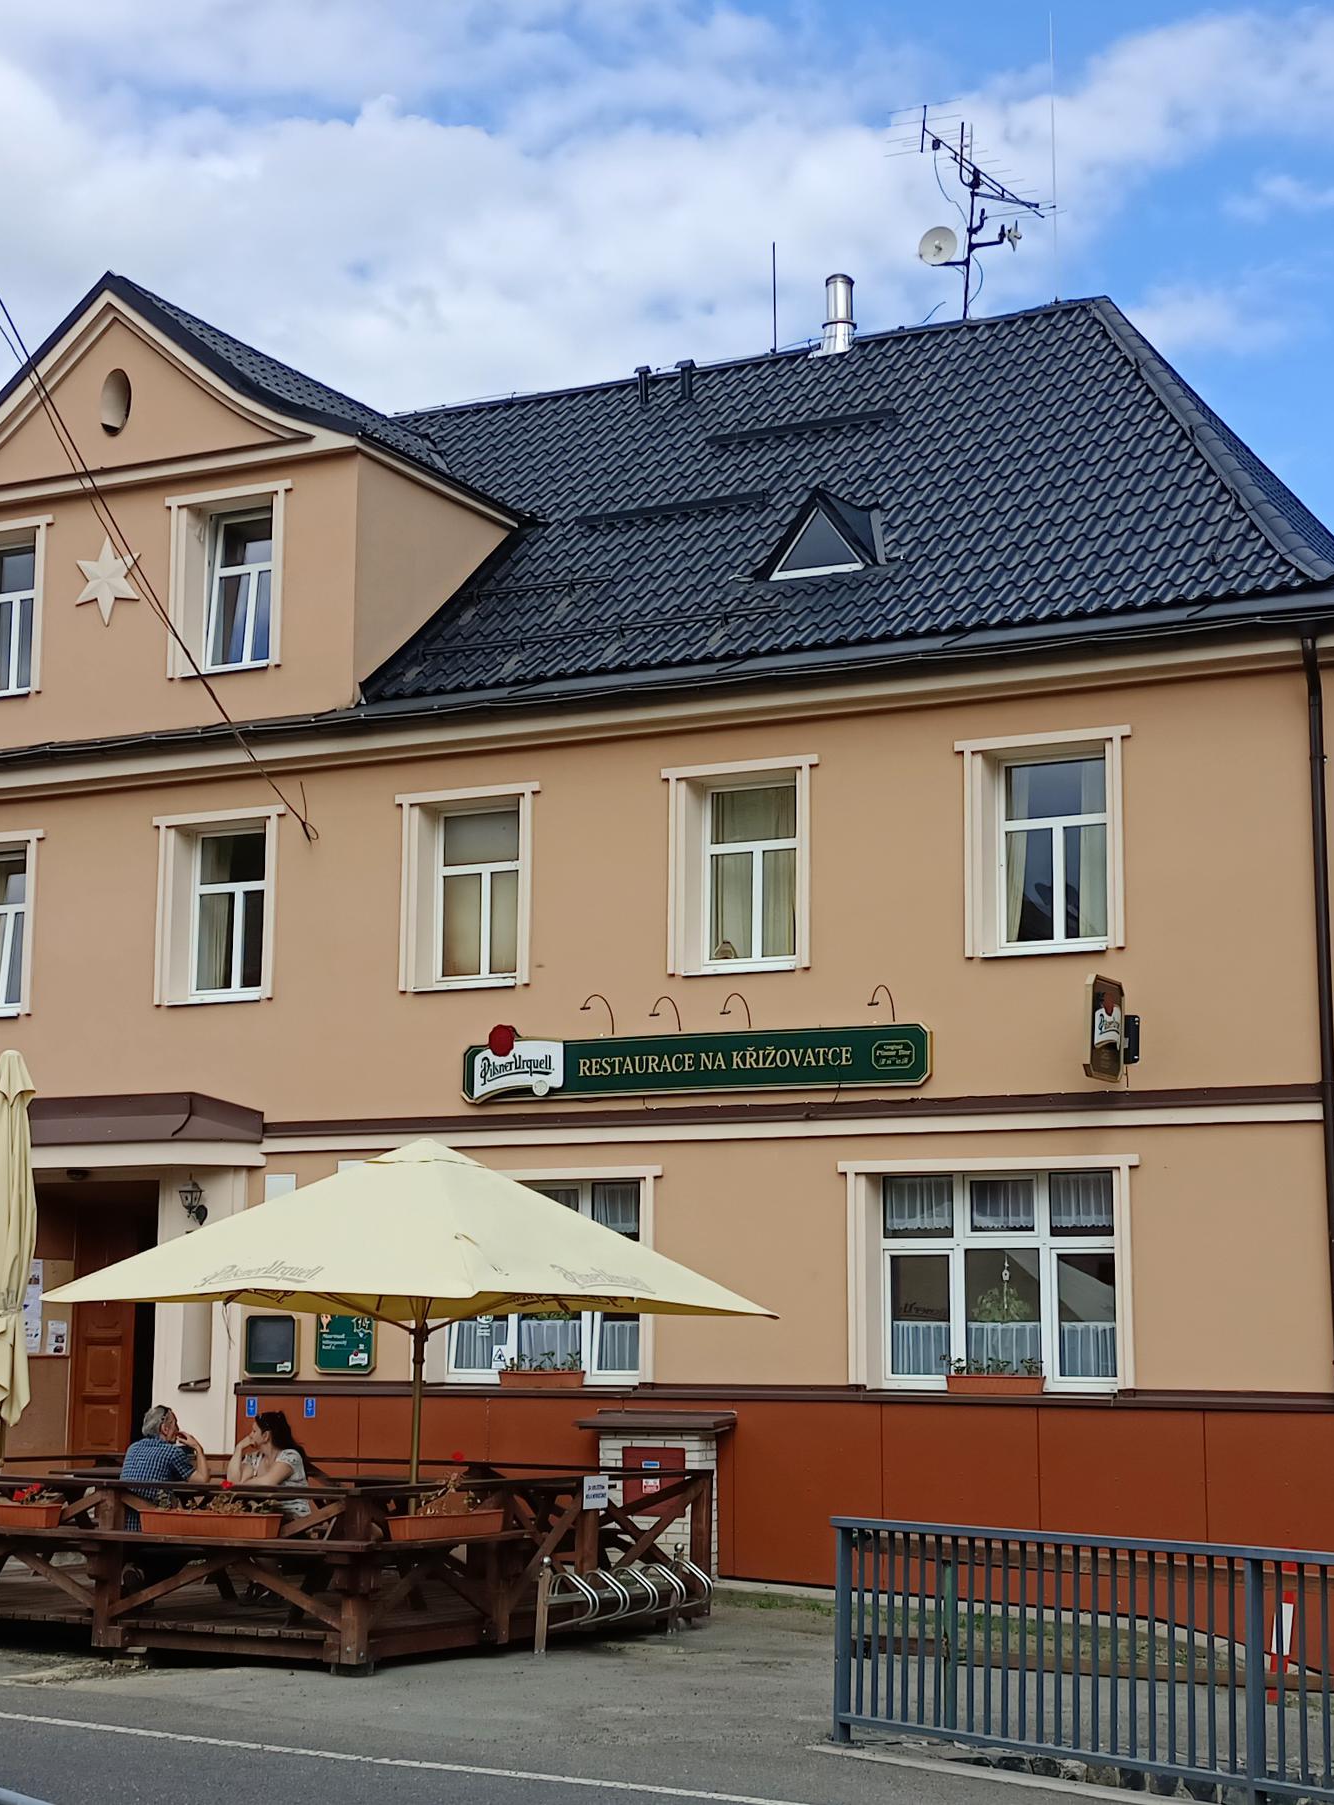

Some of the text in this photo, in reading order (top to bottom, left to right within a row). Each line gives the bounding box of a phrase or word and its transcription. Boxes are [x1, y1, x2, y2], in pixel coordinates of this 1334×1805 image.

[480, 1056, 515, 1086] Pilsner
[578, 1046, 853, 1076] RESTAURACE NA KŘIŽOVATCE
